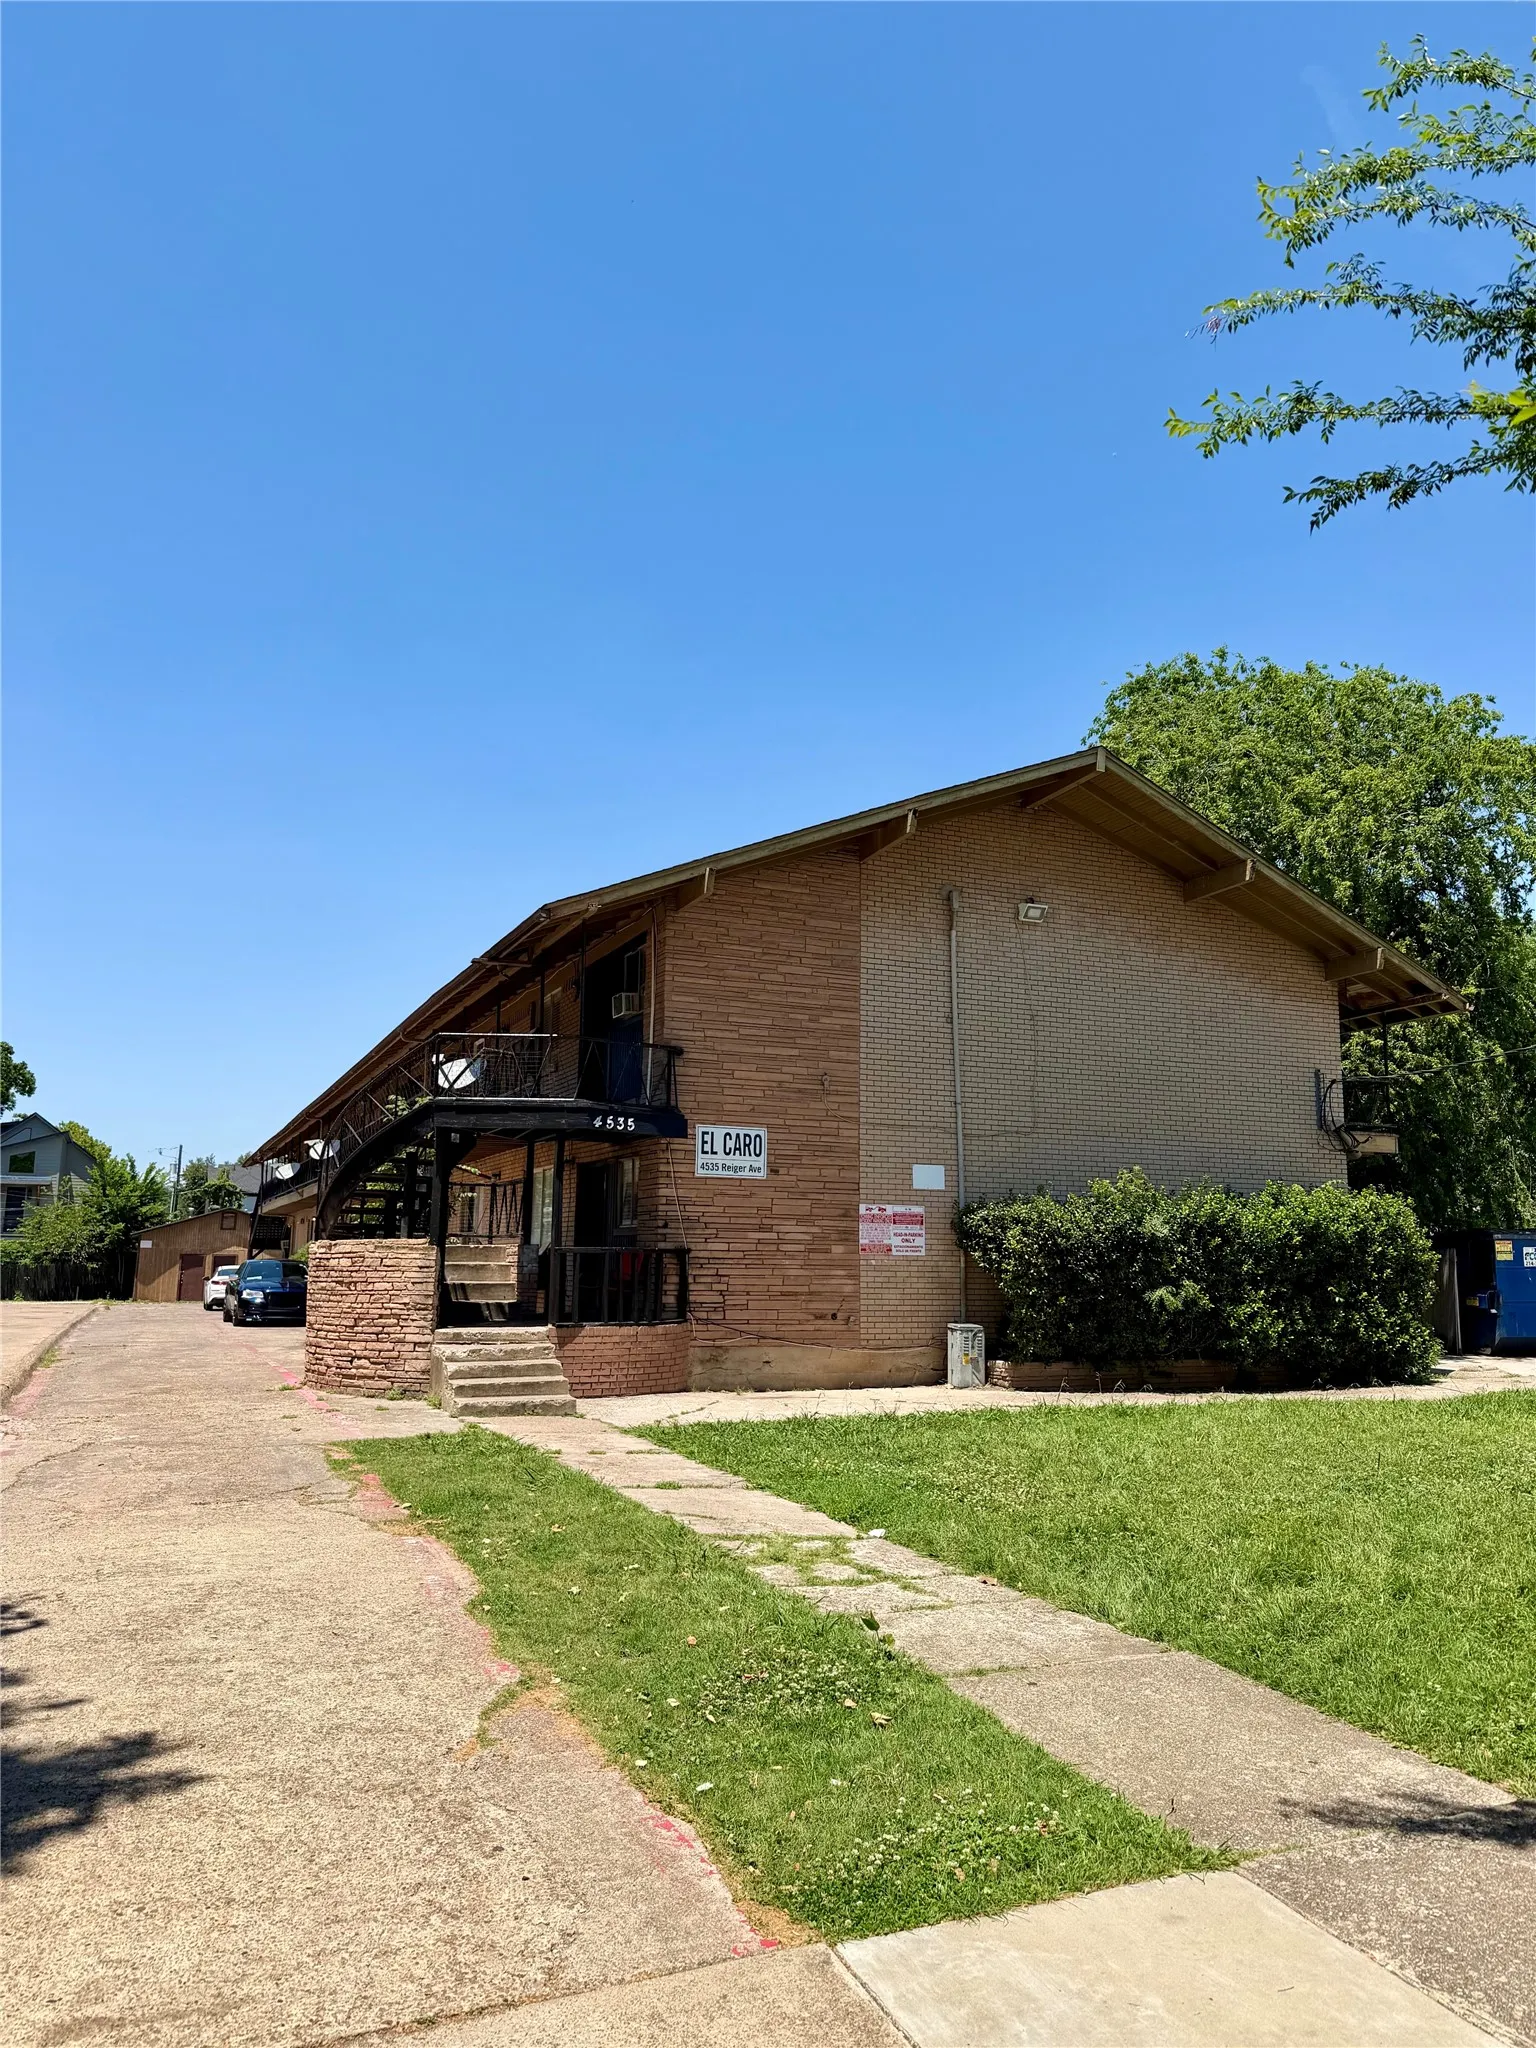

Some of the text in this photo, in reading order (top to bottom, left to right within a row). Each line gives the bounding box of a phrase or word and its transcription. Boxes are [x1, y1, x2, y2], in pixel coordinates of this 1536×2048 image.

[593, 1115, 636, 1131] 4535
[701, 1131, 763, 1157] EL CARO
[700, 1162, 762, 1174] 4535 Reiger Ave
